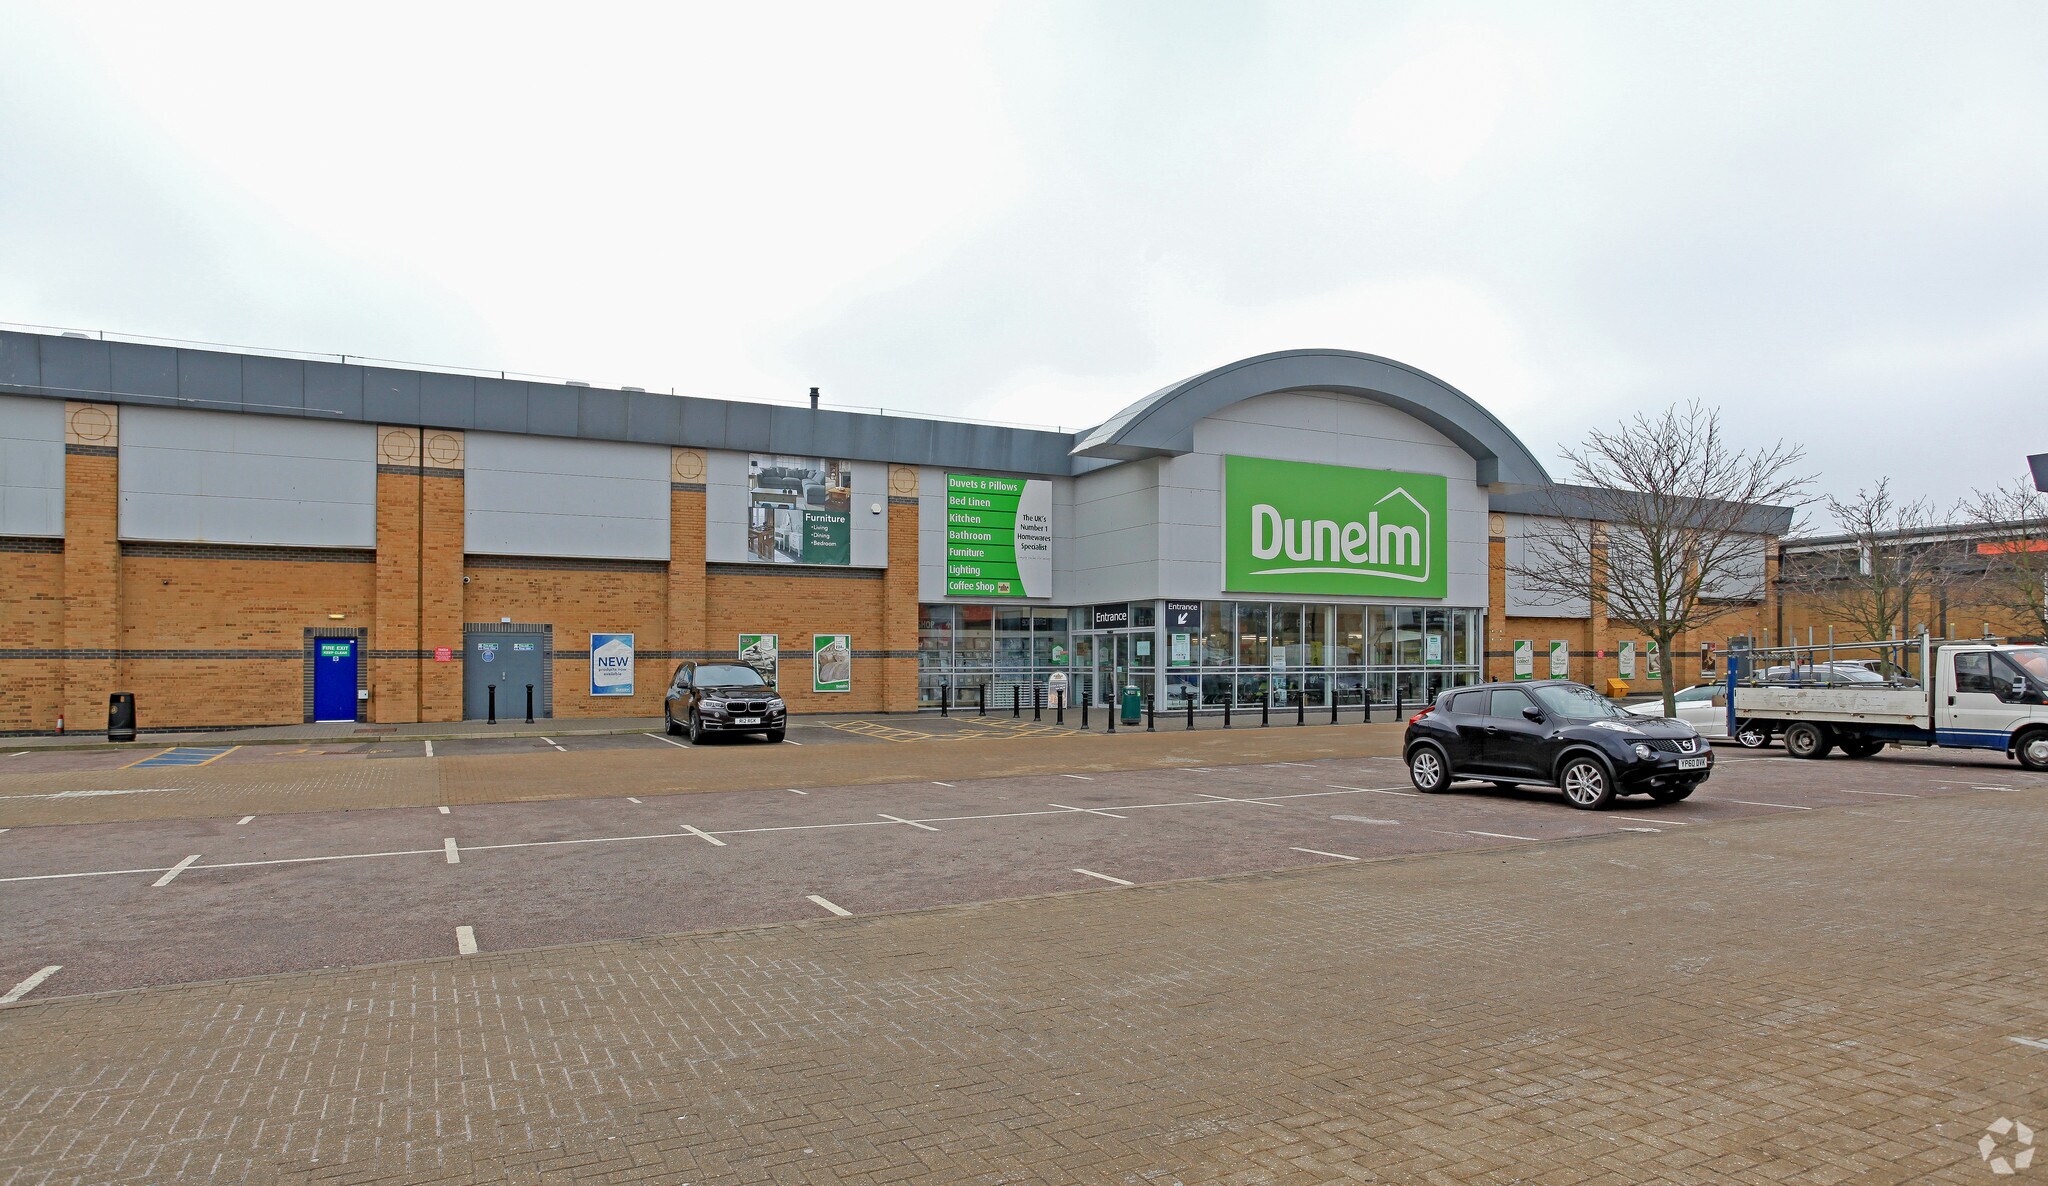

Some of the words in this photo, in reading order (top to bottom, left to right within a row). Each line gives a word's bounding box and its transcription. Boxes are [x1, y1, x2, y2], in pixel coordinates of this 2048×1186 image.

[949, 478, 978, 489] Duvets
[981, 481, 986, 489] &
[988, 481, 1018, 491] Pillows
[949, 496, 966, 506] Bed
[968, 497, 991, 507] Linen
[805, 513, 846, 523] Furniture
[949, 513, 981, 523] Kitchen
[1022, 514, 1033, 522] The
[1034, 515, 1046, 523] UK's
[1020, 524, 1043, 532] Number
[949, 530, 992, 541] Bathroom
[1017, 534, 1051, 542] Homewares
[1251, 503, 1420, 566] Dunelm
[1021, 542, 1048, 551] Specialist
[949, 548, 984, 557] Furniture
[949, 565, 981, 577] Lighting
[949, 581, 974, 591] Coffee
[975, 581, 995, 593] Shop
[1168, 603, 1198, 611] Entrance
[1096, 612, 1127, 623] Entrance
[598, 657, 629, 667] NEW
[1680, 759, 1695, 768] YP60
